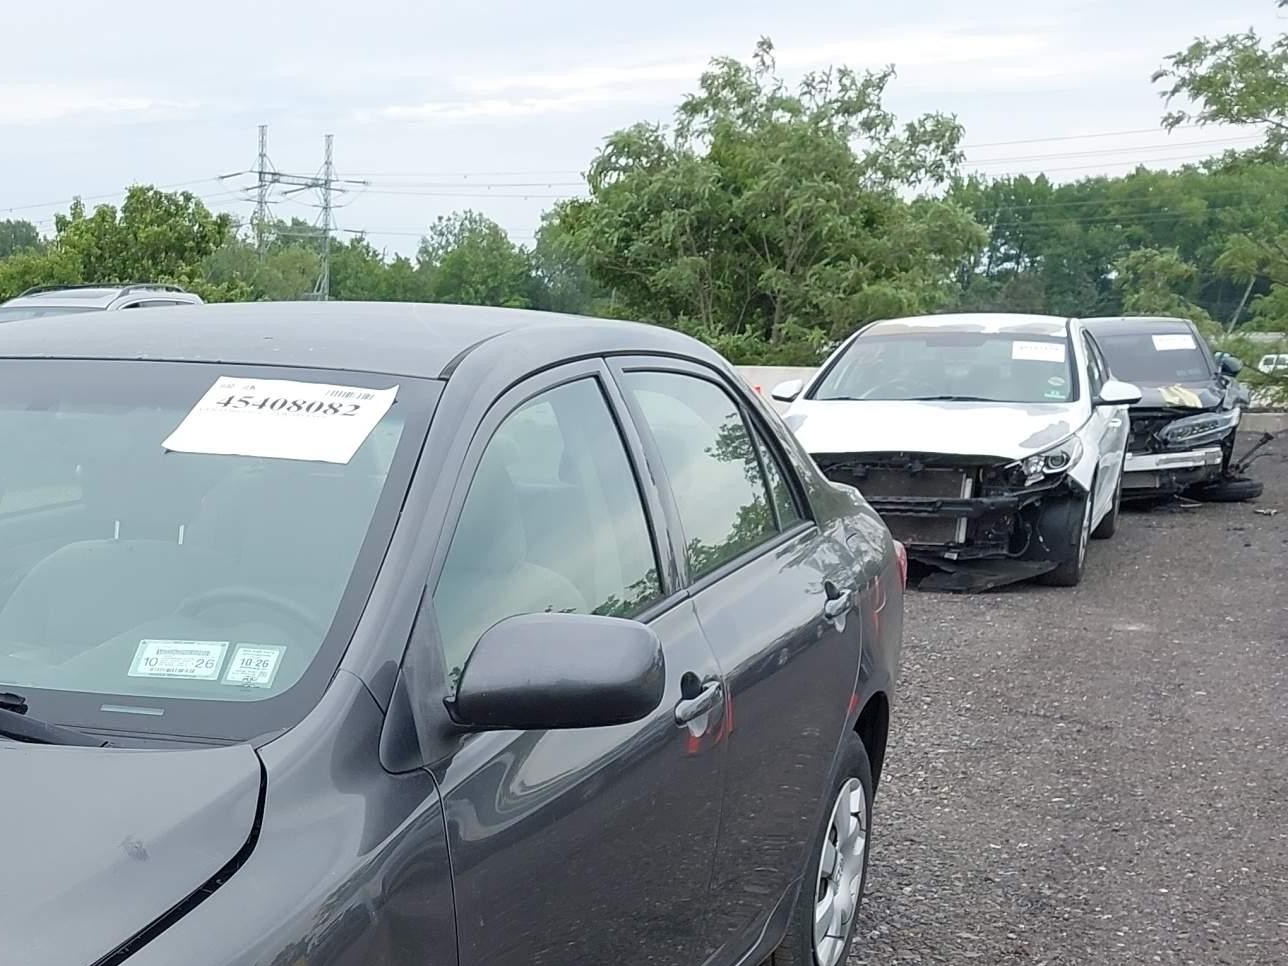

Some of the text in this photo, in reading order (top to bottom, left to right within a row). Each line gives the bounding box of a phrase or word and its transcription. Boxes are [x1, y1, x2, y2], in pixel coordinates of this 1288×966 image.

[216, 395, 361, 417] 45408082
[144, 656, 159, 667] 10
[195, 658, 215, 669] 26
